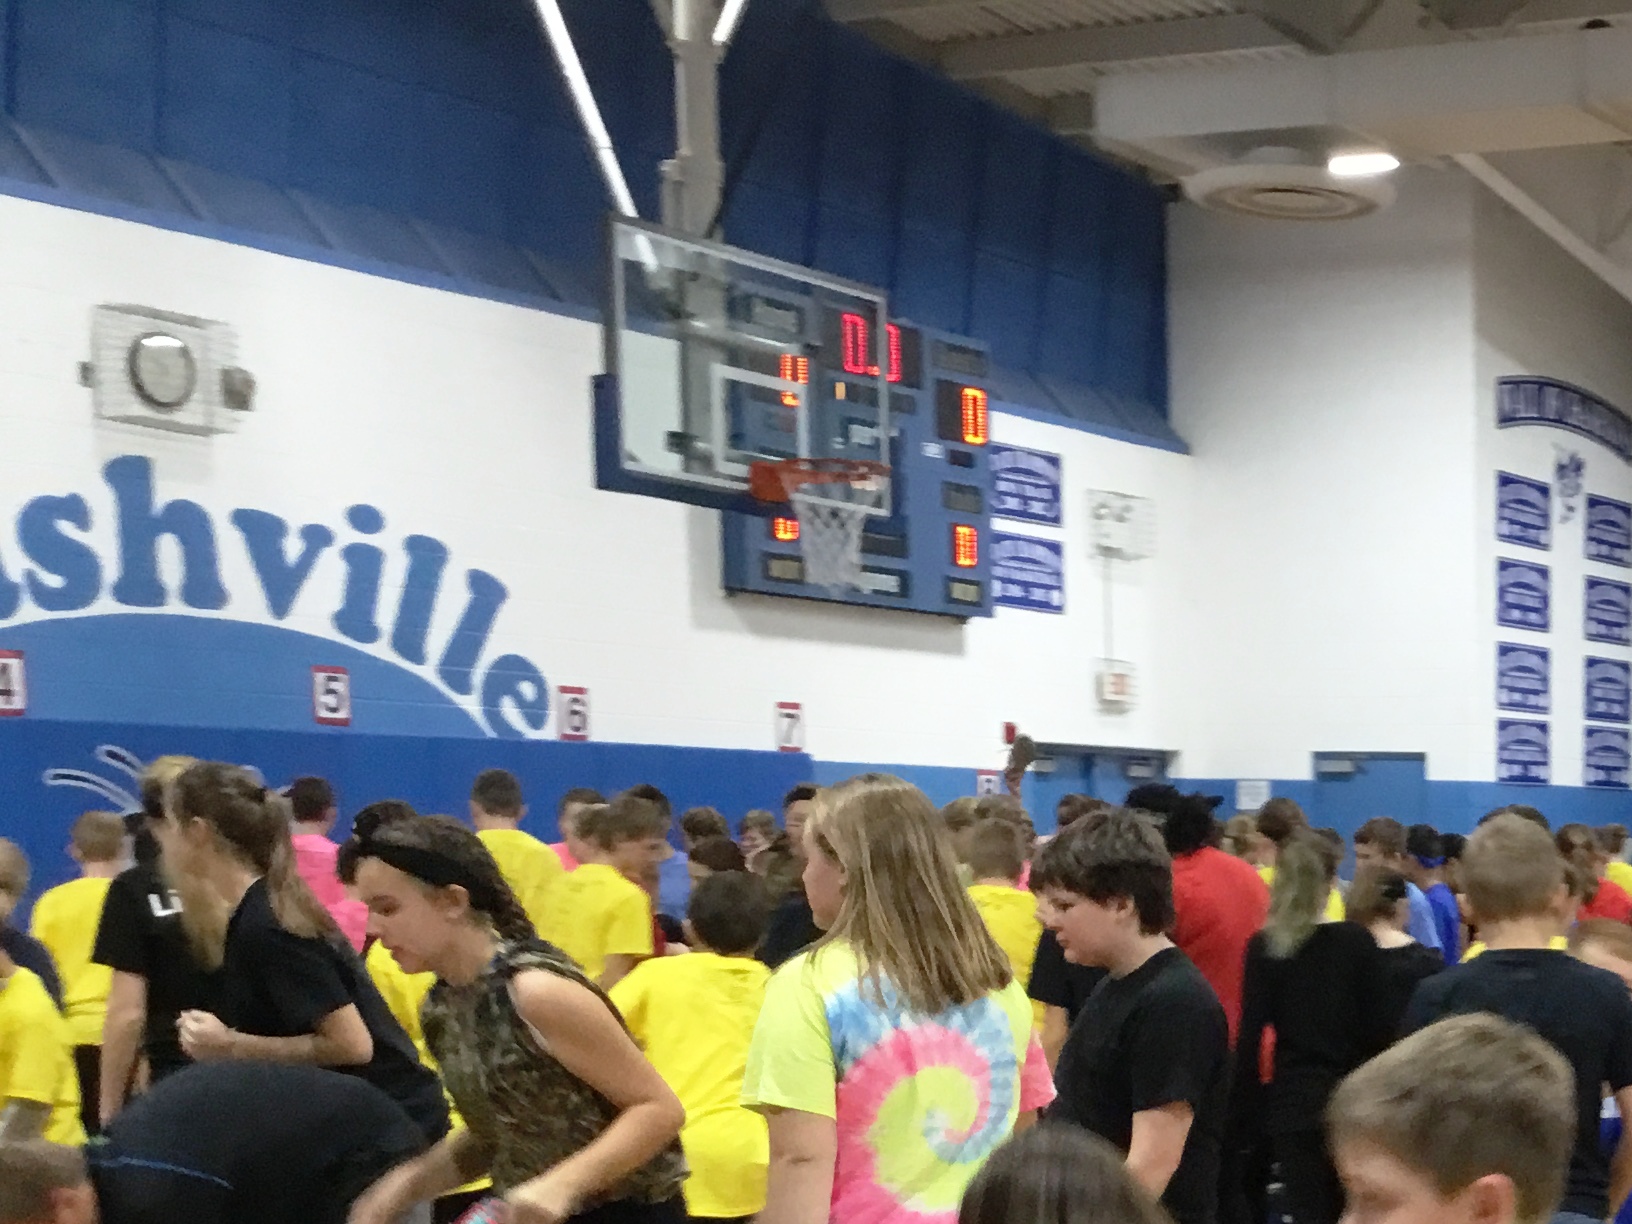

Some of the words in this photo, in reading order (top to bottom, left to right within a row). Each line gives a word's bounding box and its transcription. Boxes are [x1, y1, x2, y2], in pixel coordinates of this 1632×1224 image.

[961, 387, 989, 446] 0
[0, 454, 550, 736] shville
[319, 675, 346, 713] 5
[567, 697, 587, 732] 6
[778, 712, 800, 744] 7
